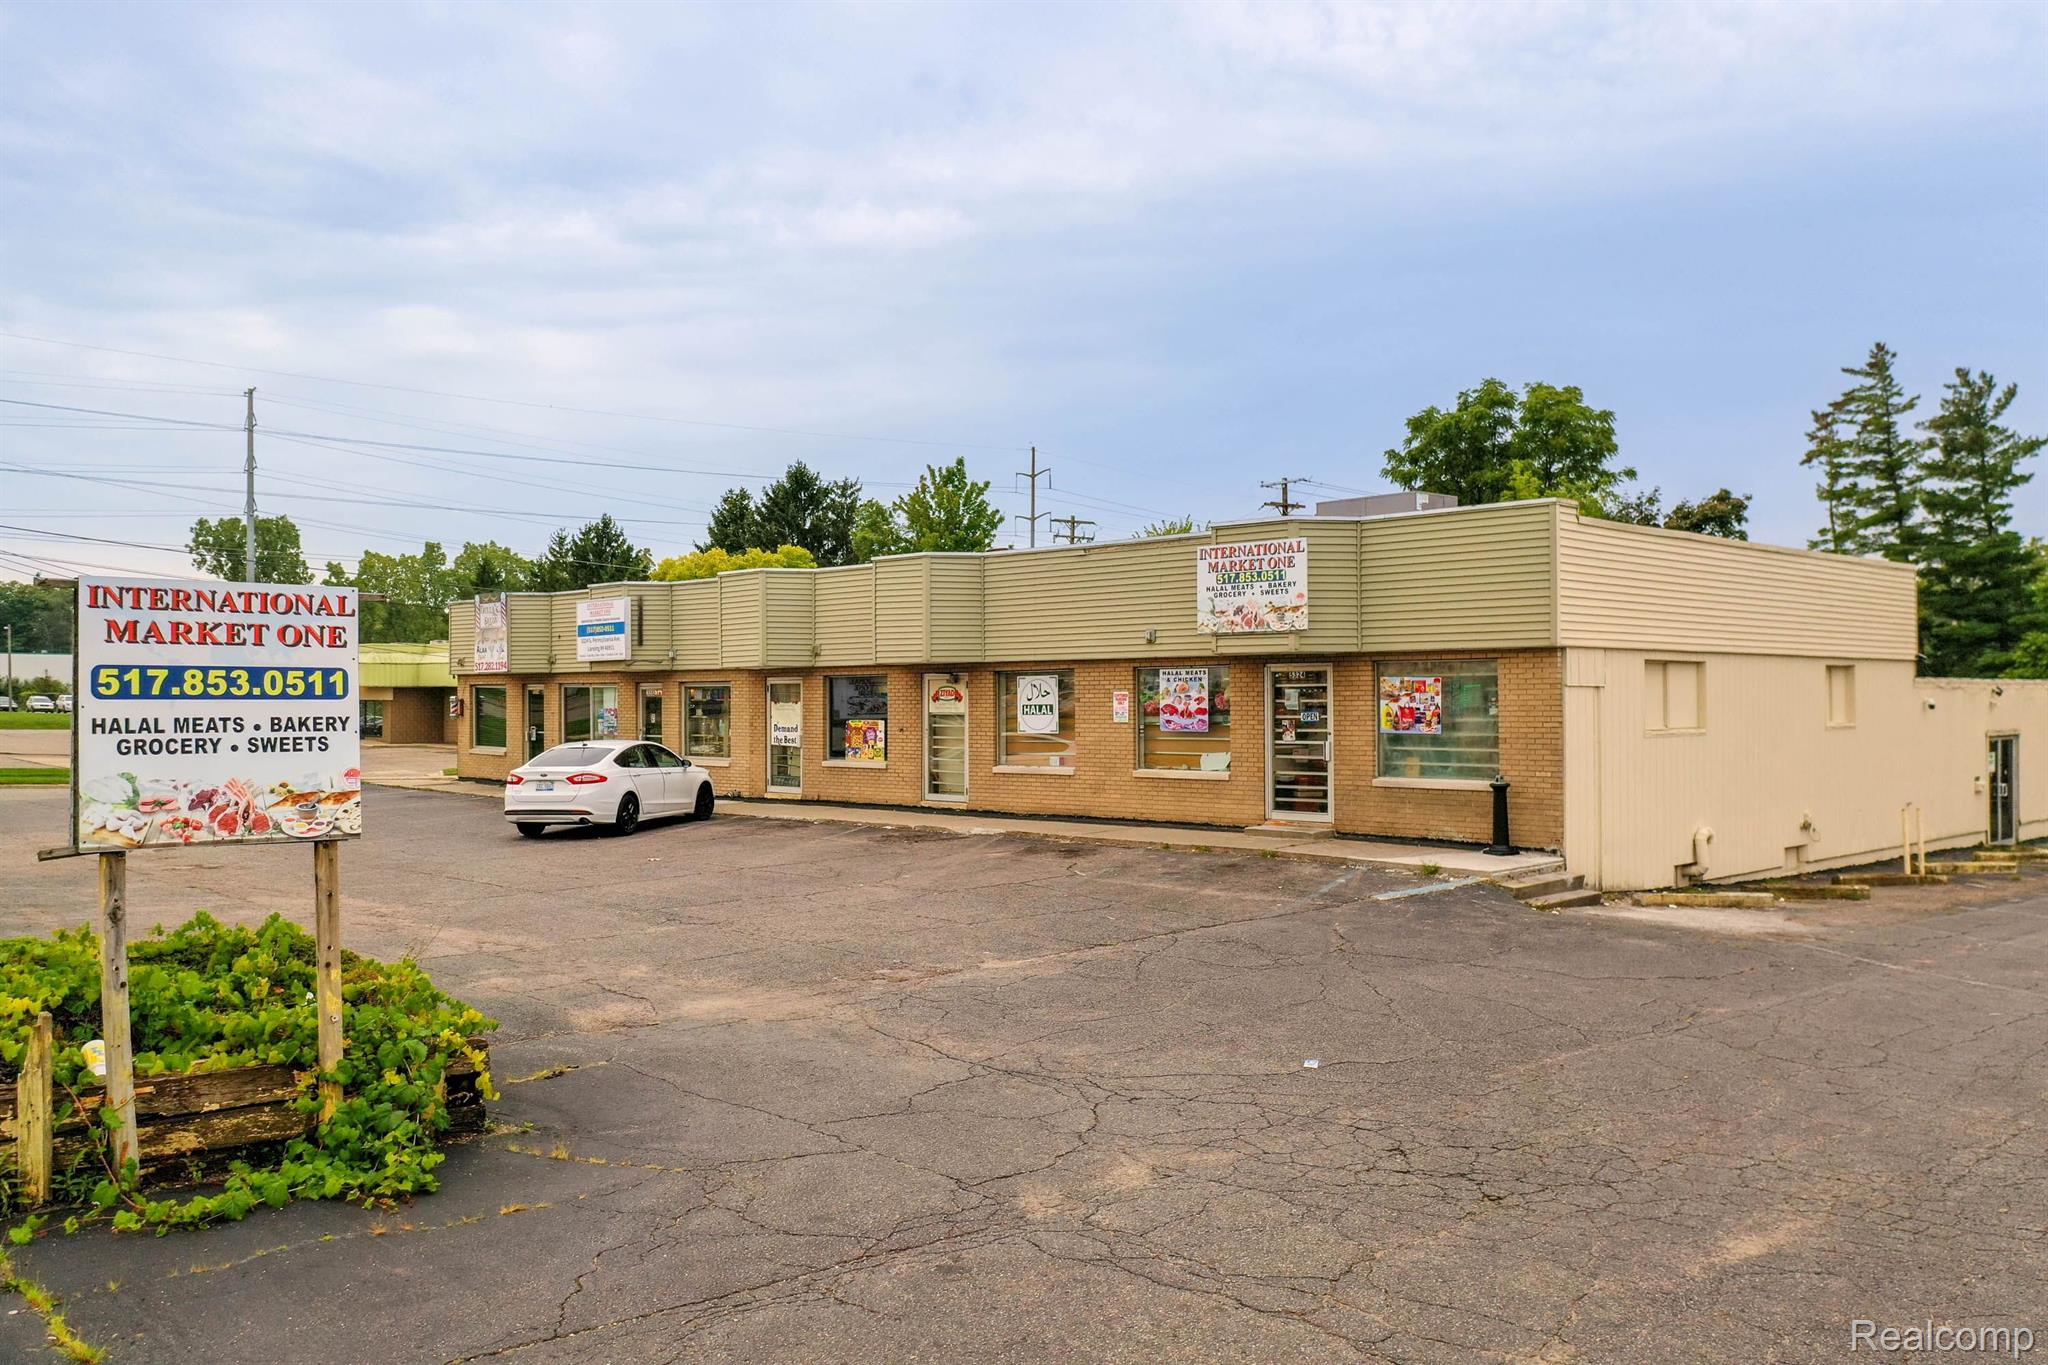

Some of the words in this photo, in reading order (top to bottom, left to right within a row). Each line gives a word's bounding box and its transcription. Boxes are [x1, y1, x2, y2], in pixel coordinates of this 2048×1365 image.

[1199, 540, 1305, 560] INTERNATIONAL
[1208, 558, 1265, 574] MARKET
[1267, 556, 1296, 570] ONE
[1217, 570, 1287, 584] 517.853.0511
[1268, 581, 1297, 589] BAKERY
[87, 584, 356, 618] INTERNATIONAL
[1213, 591, 1246, 599] GROCERY
[1260, 588, 1289, 596] SWEETS
[104, 618, 270, 647] MARKET
[276, 623, 348, 649] ONE
[97, 668, 345, 696] 517.853.0511
[1026, 683, 1051, 701] حلال
[1023, 704, 1052, 715] HALAL
[91, 717, 165, 735] HALAL
[173, 716, 245, 733] MEATS
[270, 716, 350, 733] BAKERY
[773, 723, 799, 733] Demand
[116, 737, 222, 755] GROCERY
[247, 736, 330, 753] SWEETS
[773, 735, 783, 744] the
[783, 735, 797, 744] Best
